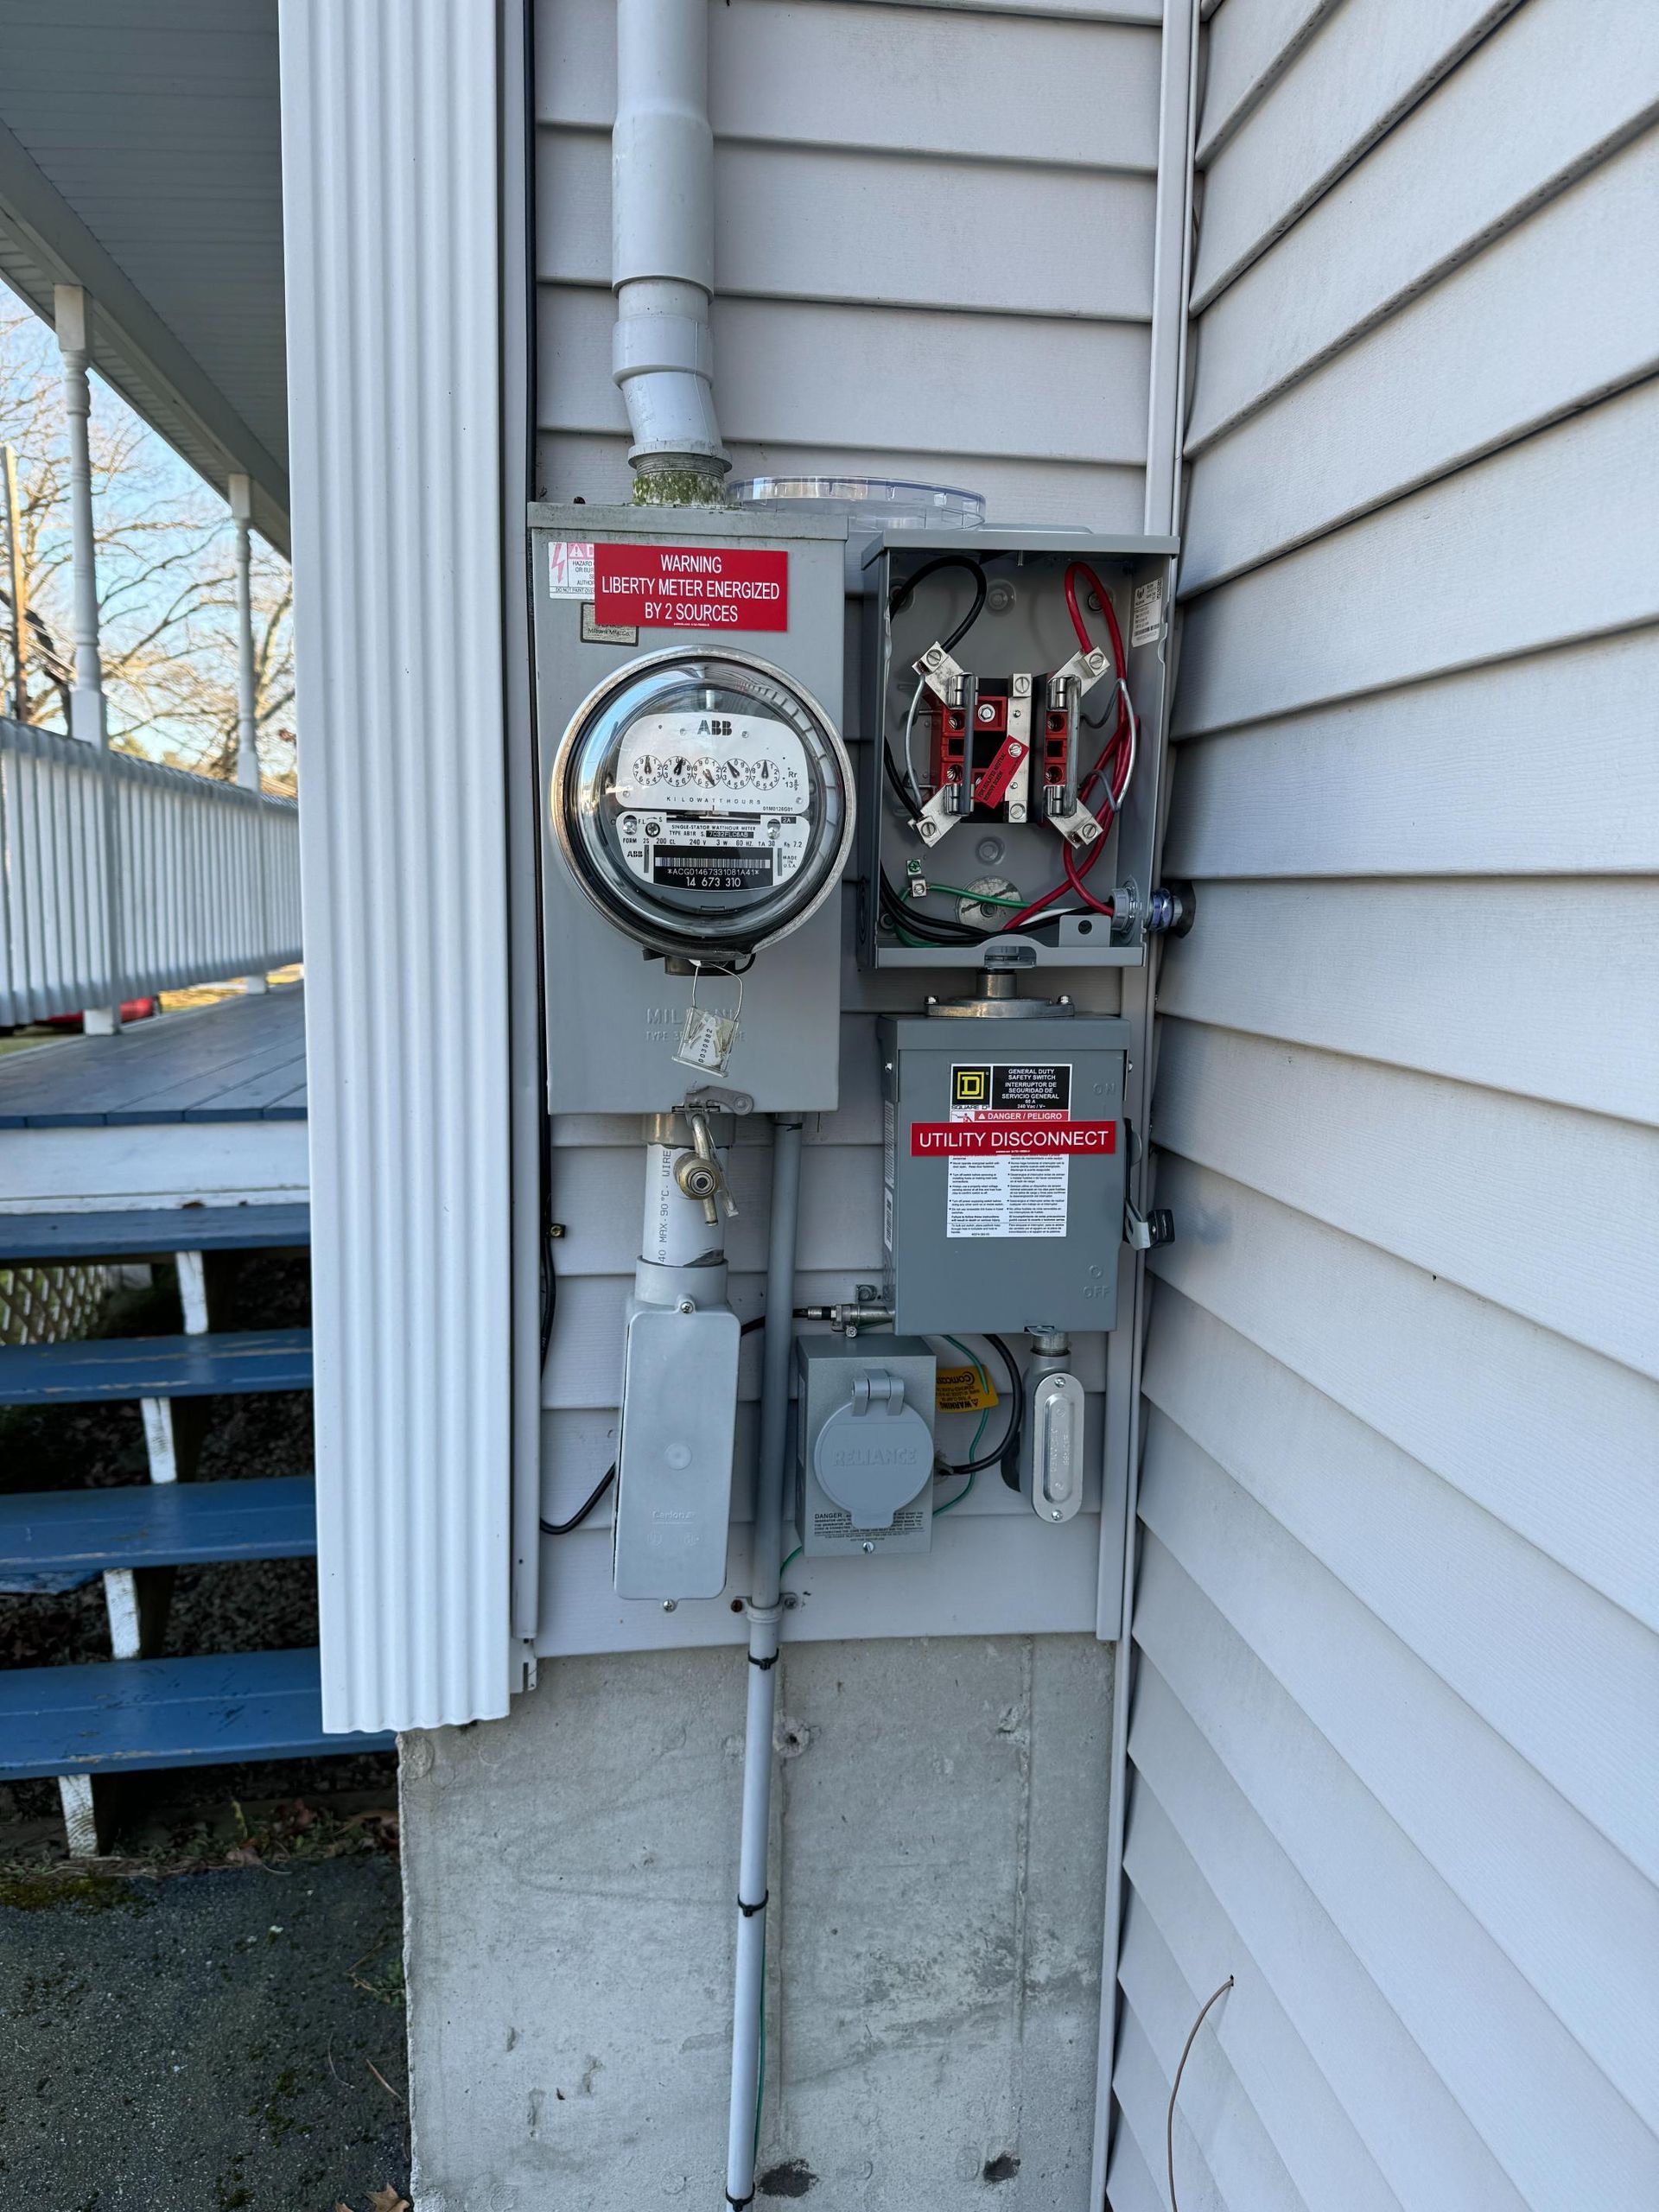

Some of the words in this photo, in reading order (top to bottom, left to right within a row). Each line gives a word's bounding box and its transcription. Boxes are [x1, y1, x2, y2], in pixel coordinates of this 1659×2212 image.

[660, 554, 722, 574] WARNING
[601, 575, 656, 595] LIBERTY
[658, 578, 703, 597] METER
[706, 580, 780, 600] ENERGIZED
[645, 602, 663, 620] BY
[664, 603, 672, 620] 2
[676, 604, 739, 623] SOURCES
[696, 720, 733, 736] ABB
[666, 797, 761, 805] KILOWATTHOURS
[686, 876, 696, 887] 14
[701, 876, 721, 887] 673
[726, 878, 741, 887] 310
[698, 1028, 713, 1064] 0030882
[919, 1132, 987, 1148] UTILITY
[990, 1130, 1109, 1147] DISCONNECT
[662, 1150, 672, 1177] WIRE
[658, 1249, 667, 1262] 40
[832, 1448, 918, 1466] RELIANCE
